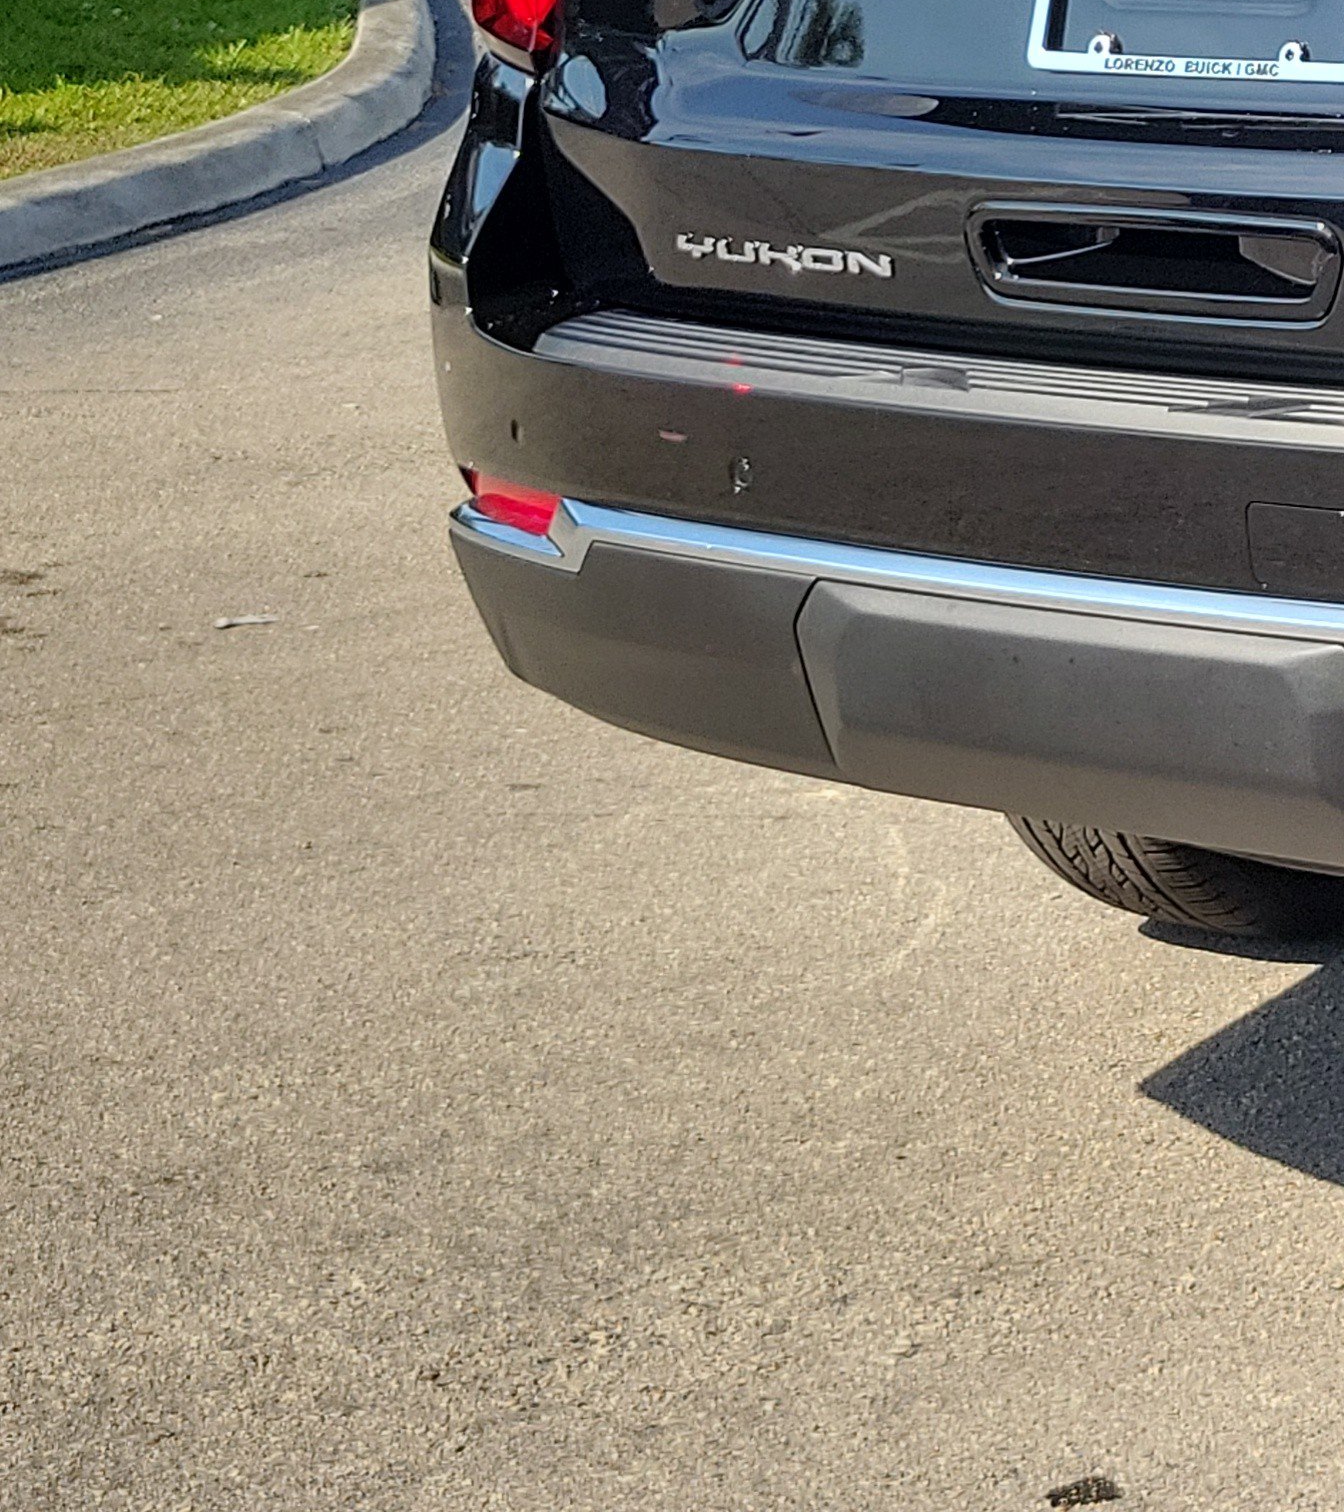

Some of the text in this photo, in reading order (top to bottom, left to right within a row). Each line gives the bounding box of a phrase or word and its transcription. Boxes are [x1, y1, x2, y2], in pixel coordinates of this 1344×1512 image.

[1104, 57, 1176, 73] LORENZO
[1184, 60, 1232, 75] BUICK
[1244, 63, 1281, 77] GMC
[677, 232, 893, 278] YUKON
